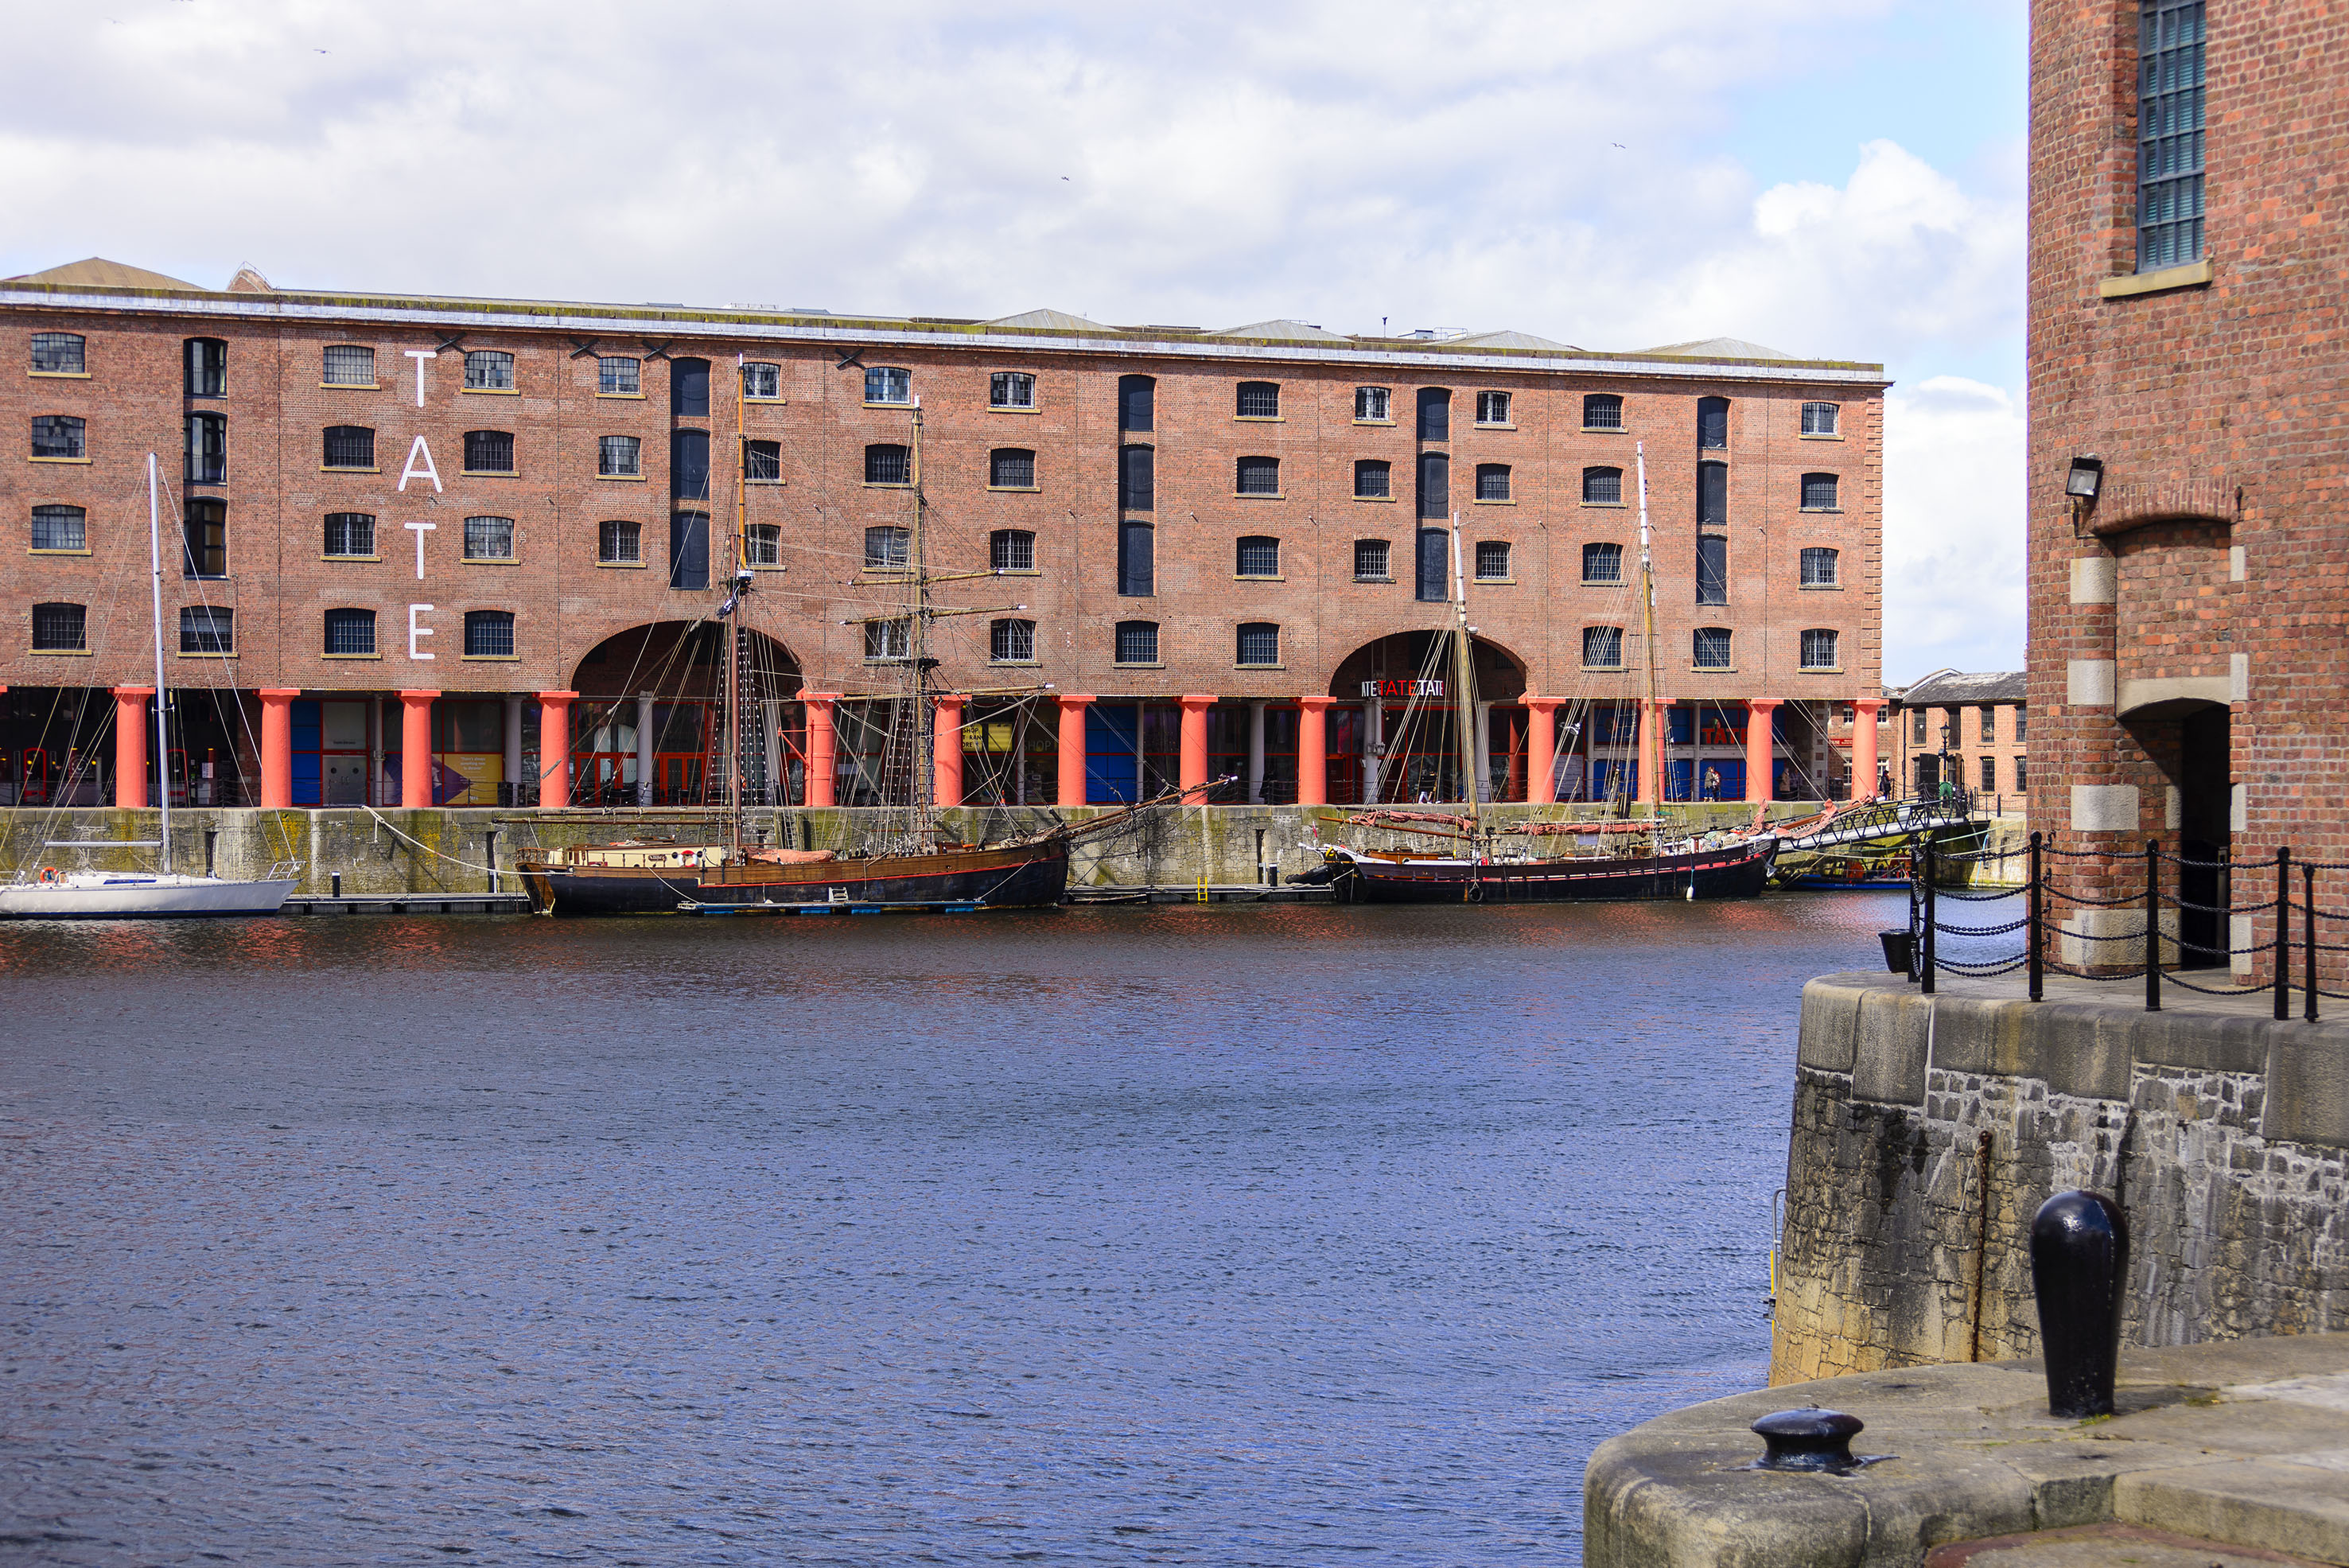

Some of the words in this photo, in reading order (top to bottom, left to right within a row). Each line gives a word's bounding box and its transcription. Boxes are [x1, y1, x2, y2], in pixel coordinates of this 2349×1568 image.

[399, 350, 442, 659] TATE
[1378, 680, 1416, 696] TATE
[1418, 679, 1443, 696] TATE
[1702, 728, 1748, 744] TATE
